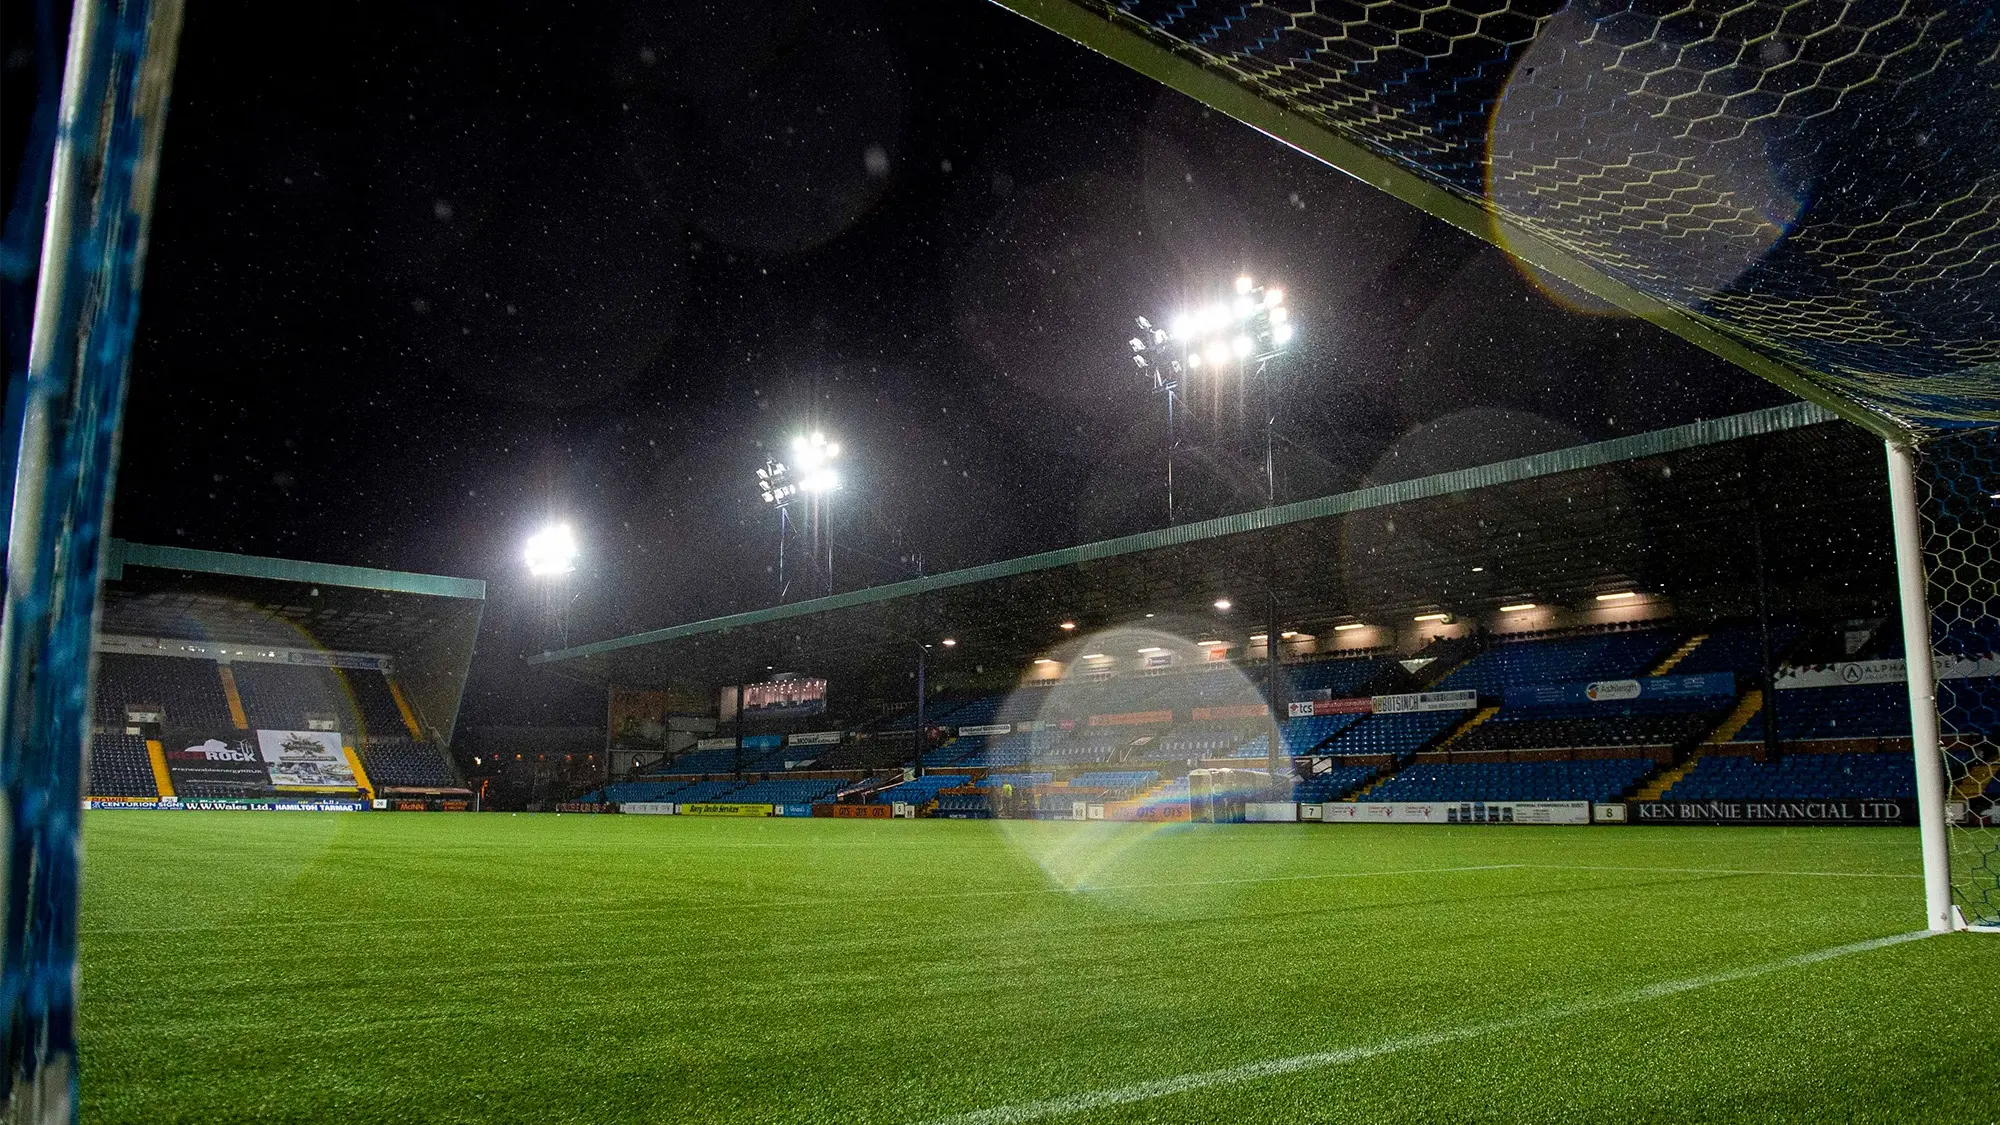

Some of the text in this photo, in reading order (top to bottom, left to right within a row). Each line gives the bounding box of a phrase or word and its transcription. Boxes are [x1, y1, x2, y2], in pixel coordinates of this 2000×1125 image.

[1300, 703, 1312, 714] tcs
[1373, 695, 1420, 713] ABBOTSINCH
[1309, 808, 1314, 816] 7
[1606, 808, 1613, 818] 8
[1639, 803, 1901, 819] KEN BINNIE FINANCIAL LTD
